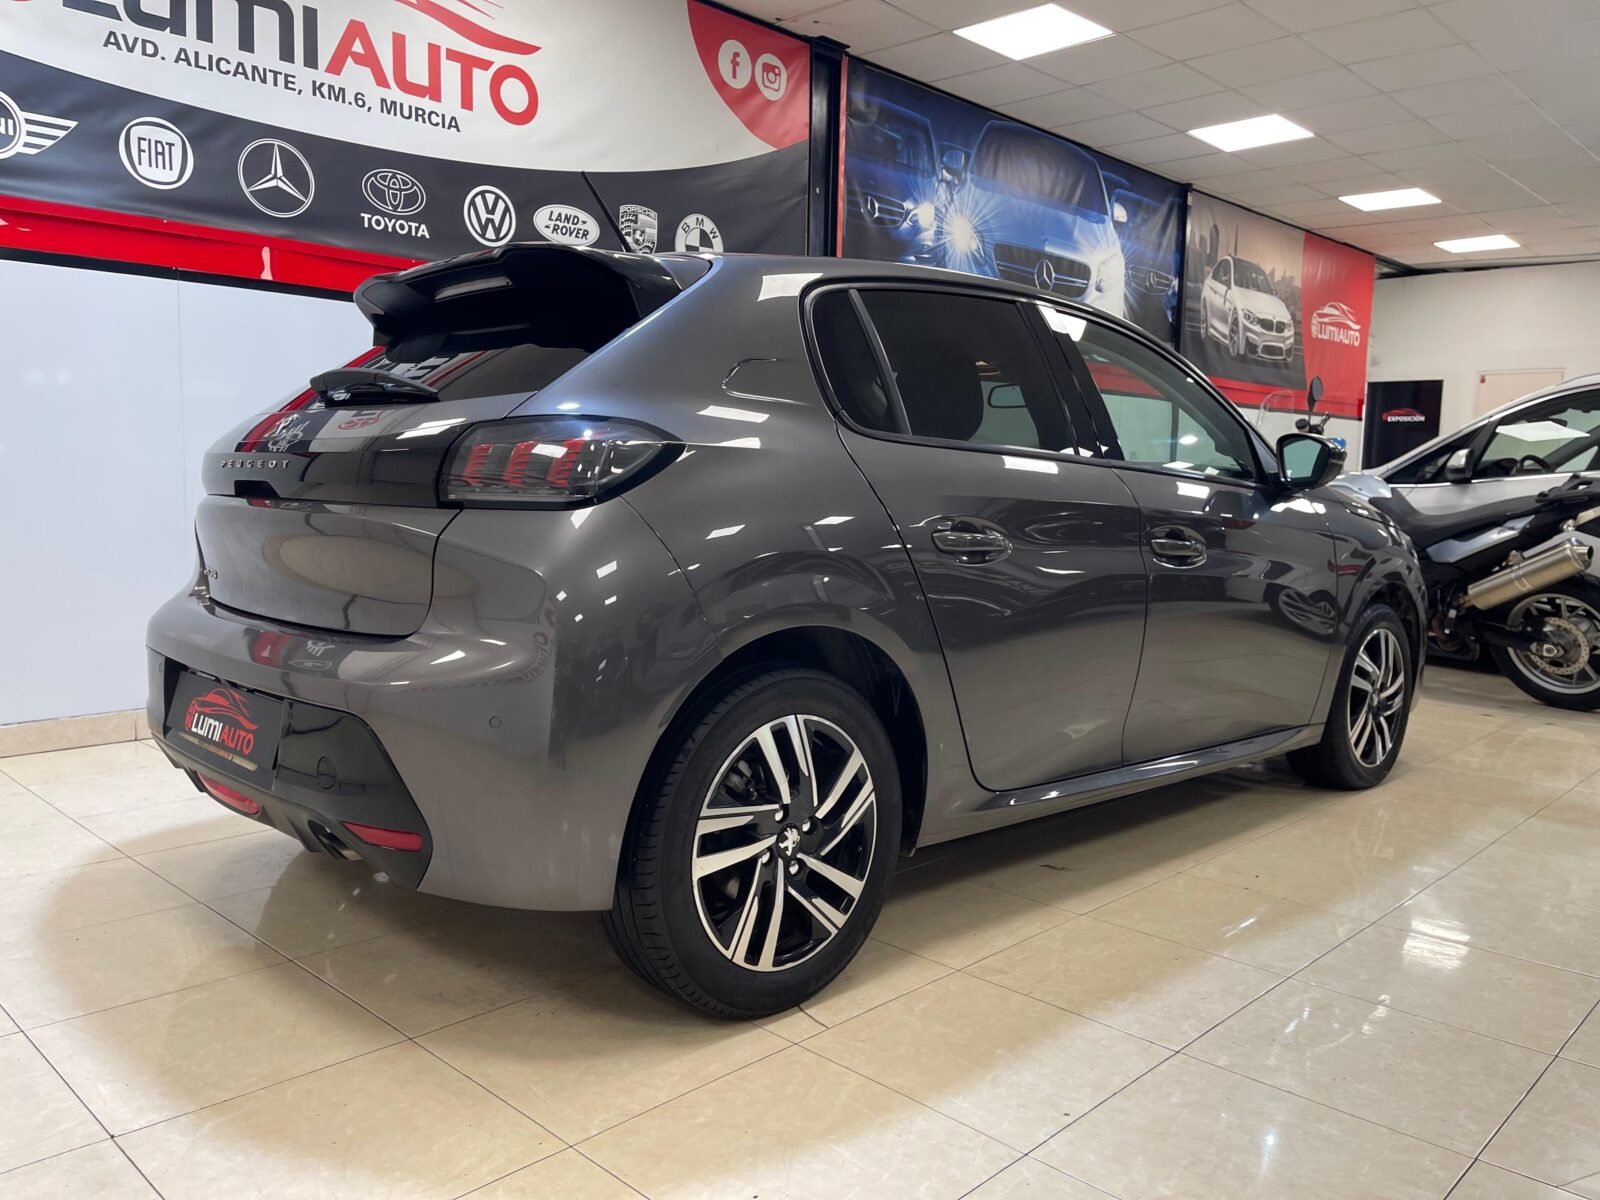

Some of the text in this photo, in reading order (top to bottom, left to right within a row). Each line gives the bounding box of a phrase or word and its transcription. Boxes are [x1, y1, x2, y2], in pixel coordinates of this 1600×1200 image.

[102, 30, 461, 133] AVD. ALICANTE, KM.6, MURCIA
[137, 136, 175, 171] FIAT
[360, 213, 430, 239] TOYOTA
[548, 210, 580, 226] LAND
[682, 216, 719, 240] BMW
[551, 224, 590, 241] ROVER
[220, 459, 290, 469] PEUGEOT
[191, 712, 254, 755] LUMIAUTO
